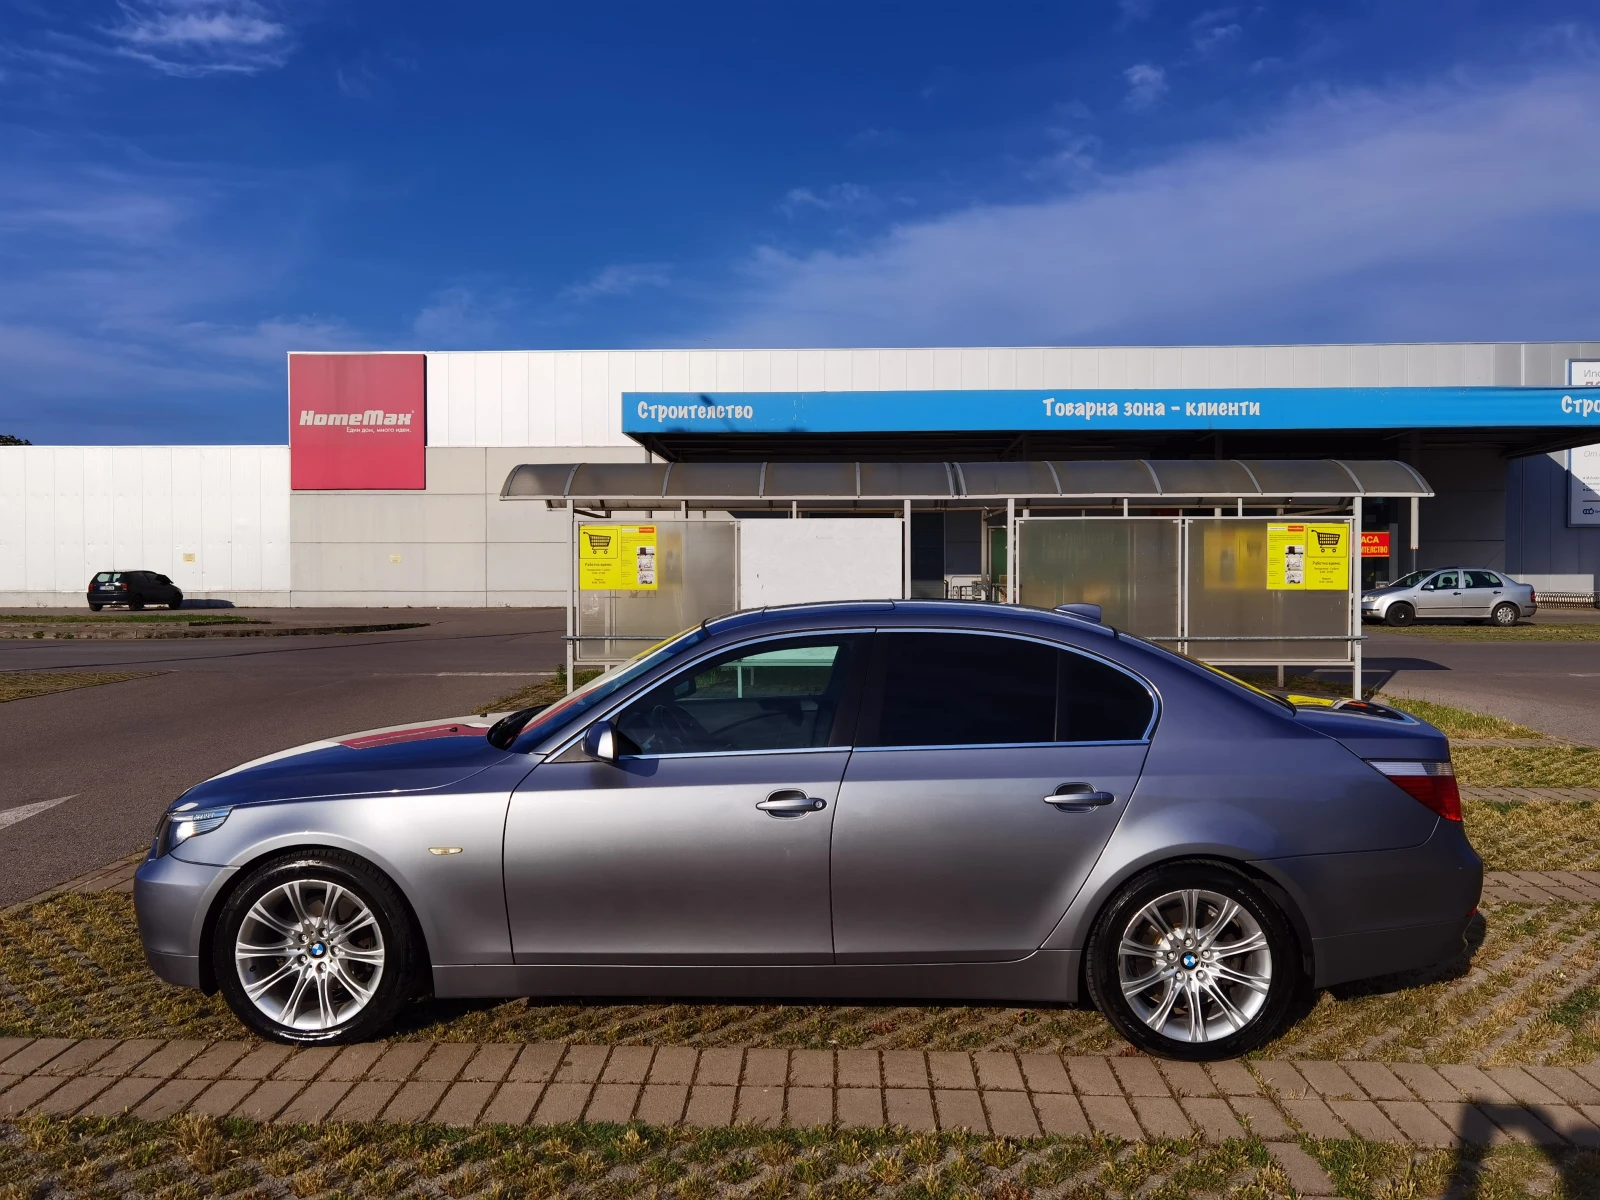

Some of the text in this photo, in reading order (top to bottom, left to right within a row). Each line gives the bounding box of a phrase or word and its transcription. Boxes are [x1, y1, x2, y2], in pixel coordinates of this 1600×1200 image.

[637, 401, 753, 422] Строителство
[1042, 398, 1118, 420] Товарна
[1123, 402, 1166, 416] зона
[1185, 402, 1260, 416] клиенти
[1361, 535, 1380, 544] АСА
